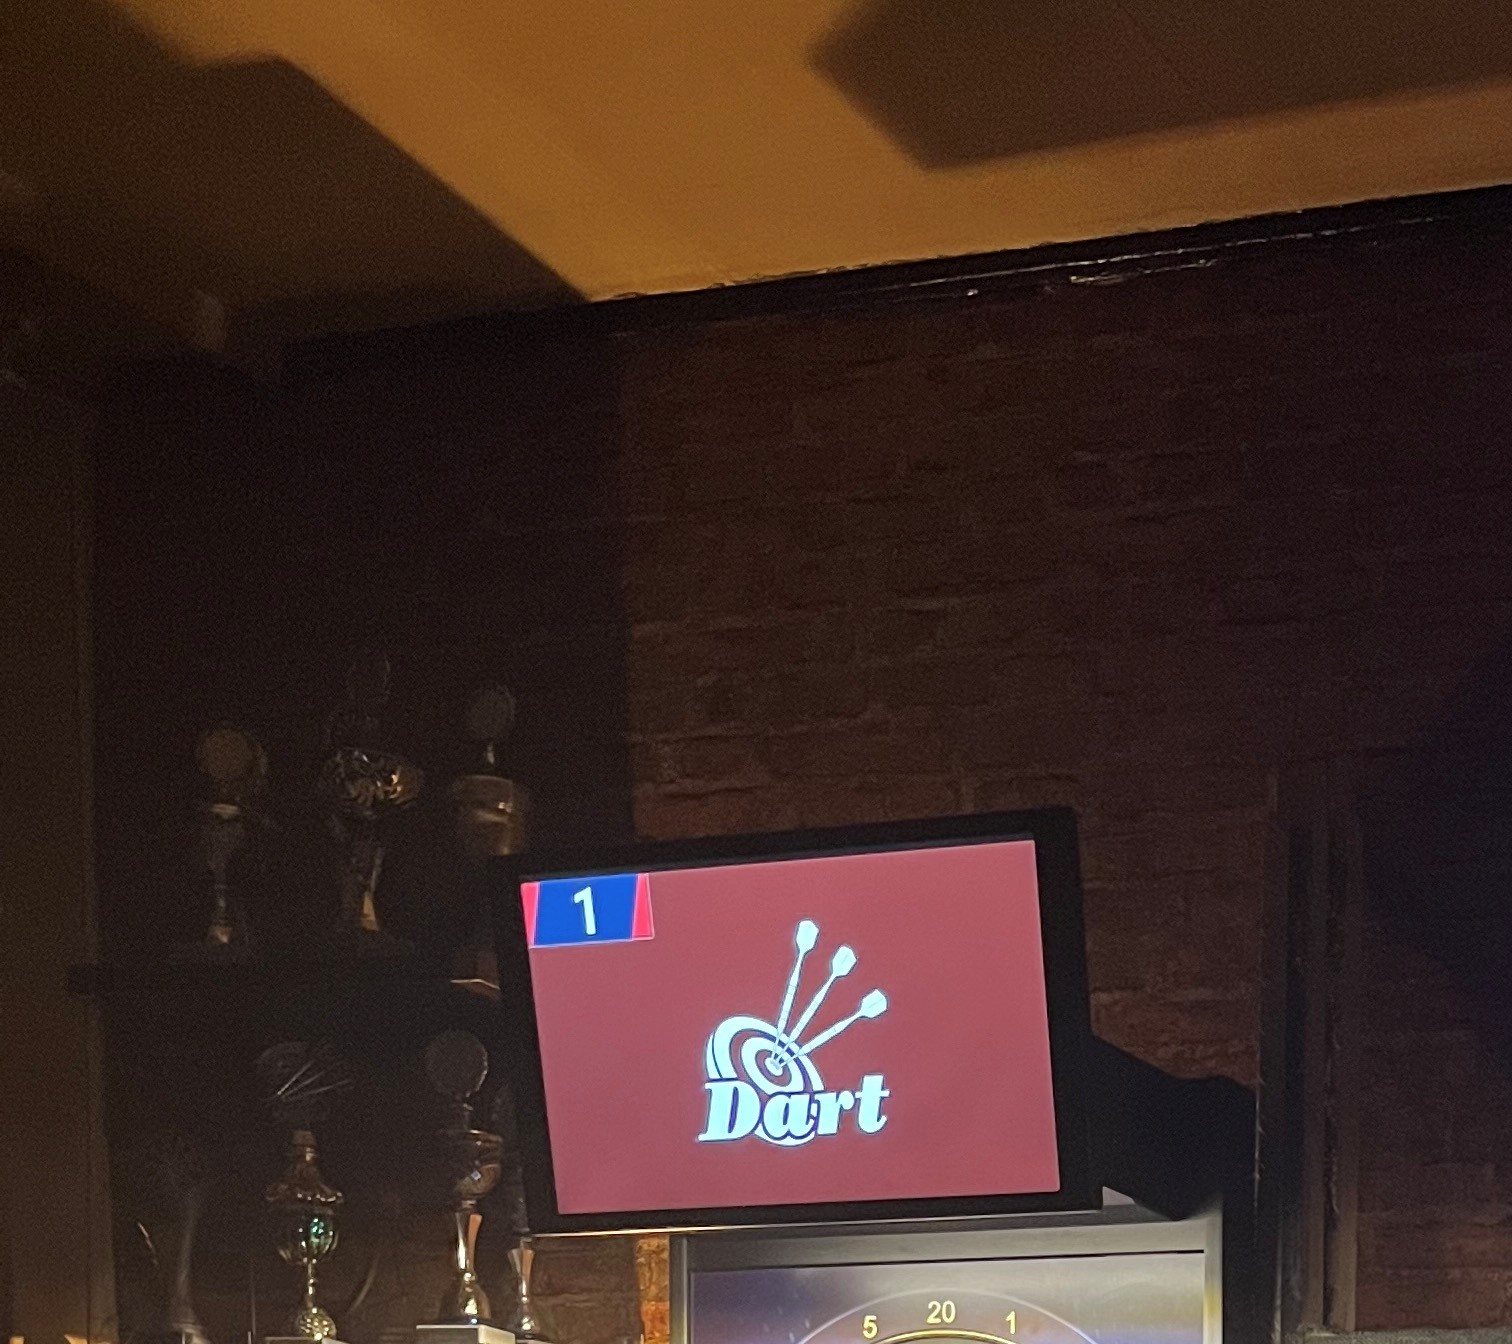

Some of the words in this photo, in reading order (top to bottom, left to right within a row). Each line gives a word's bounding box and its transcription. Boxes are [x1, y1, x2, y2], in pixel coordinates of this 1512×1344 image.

[571, 886, 598, 936] 1
[697, 1074, 891, 1144] Dart
[926, 1299, 956, 1324] 20
[1005, 1310, 1016, 1335] 1
[862, 1314, 878, 1339] 5
